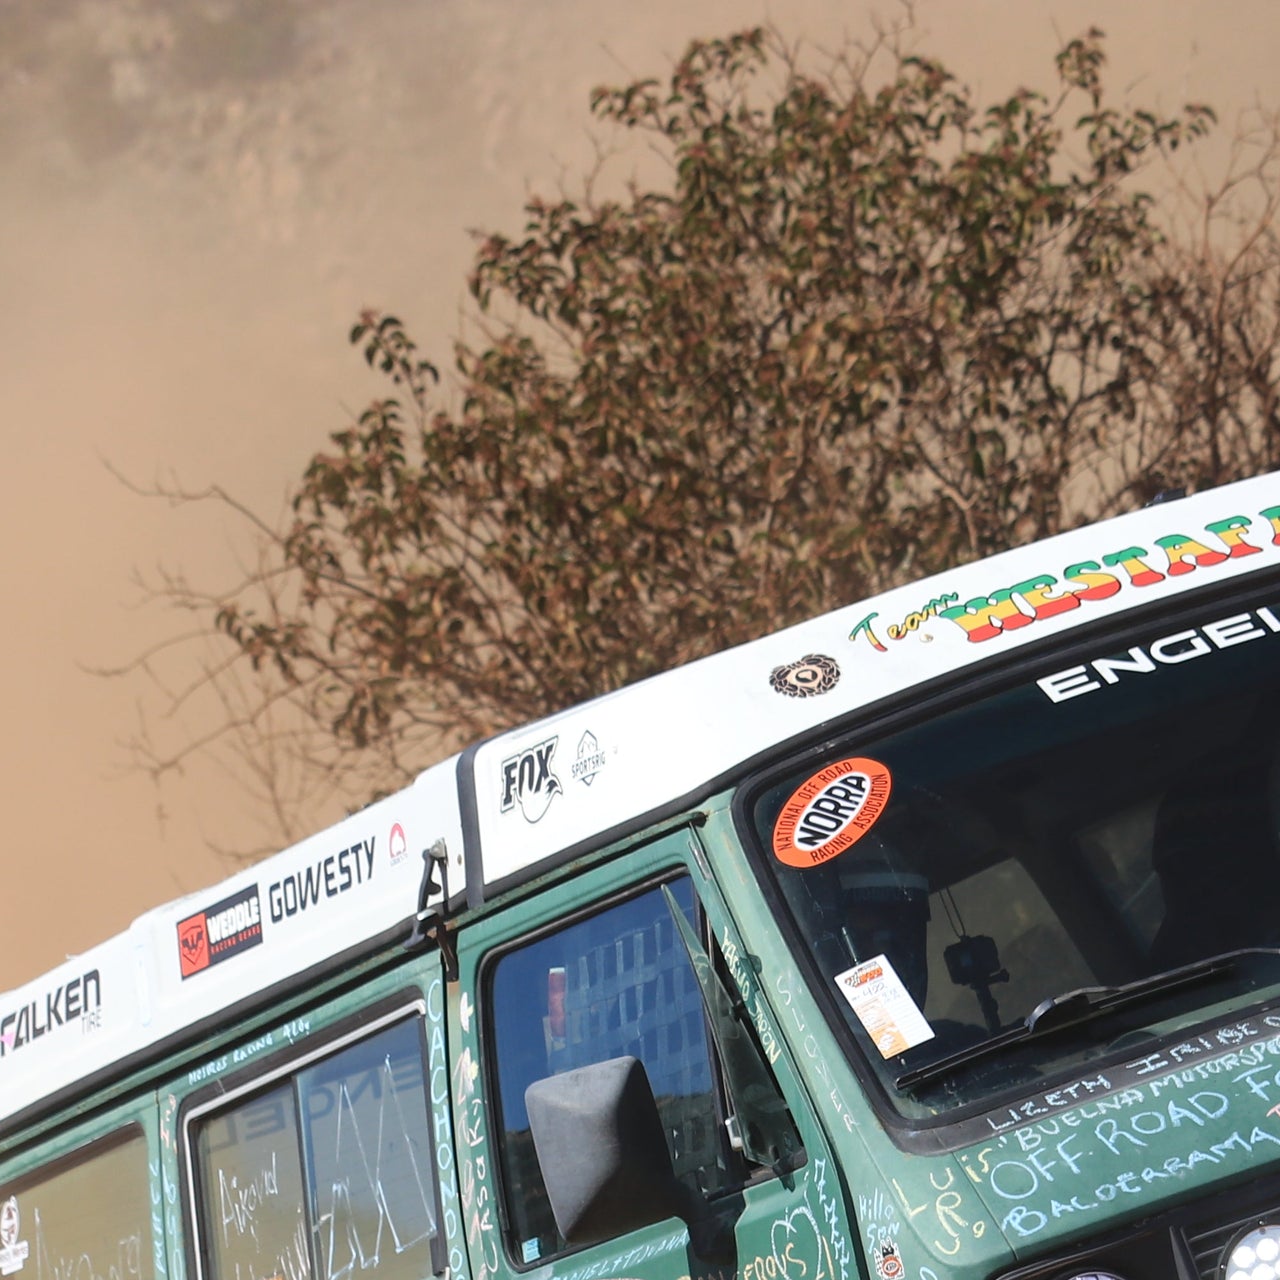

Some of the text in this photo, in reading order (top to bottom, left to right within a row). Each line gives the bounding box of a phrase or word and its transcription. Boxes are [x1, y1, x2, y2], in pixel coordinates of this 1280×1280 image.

[849, 590, 959, 652] Team
[503, 743, 554, 806] FOX
[776, 762, 853, 851] NATIONAL OFF ROAD
[797, 775, 867, 847] NORRA
[810, 773, 888, 862] RACING ASSOCIATION
[207, 896, 260, 943] WEDDLE
[269, 836, 375, 924] GOWESTY
[0, 968, 101, 1057] FALKEN
